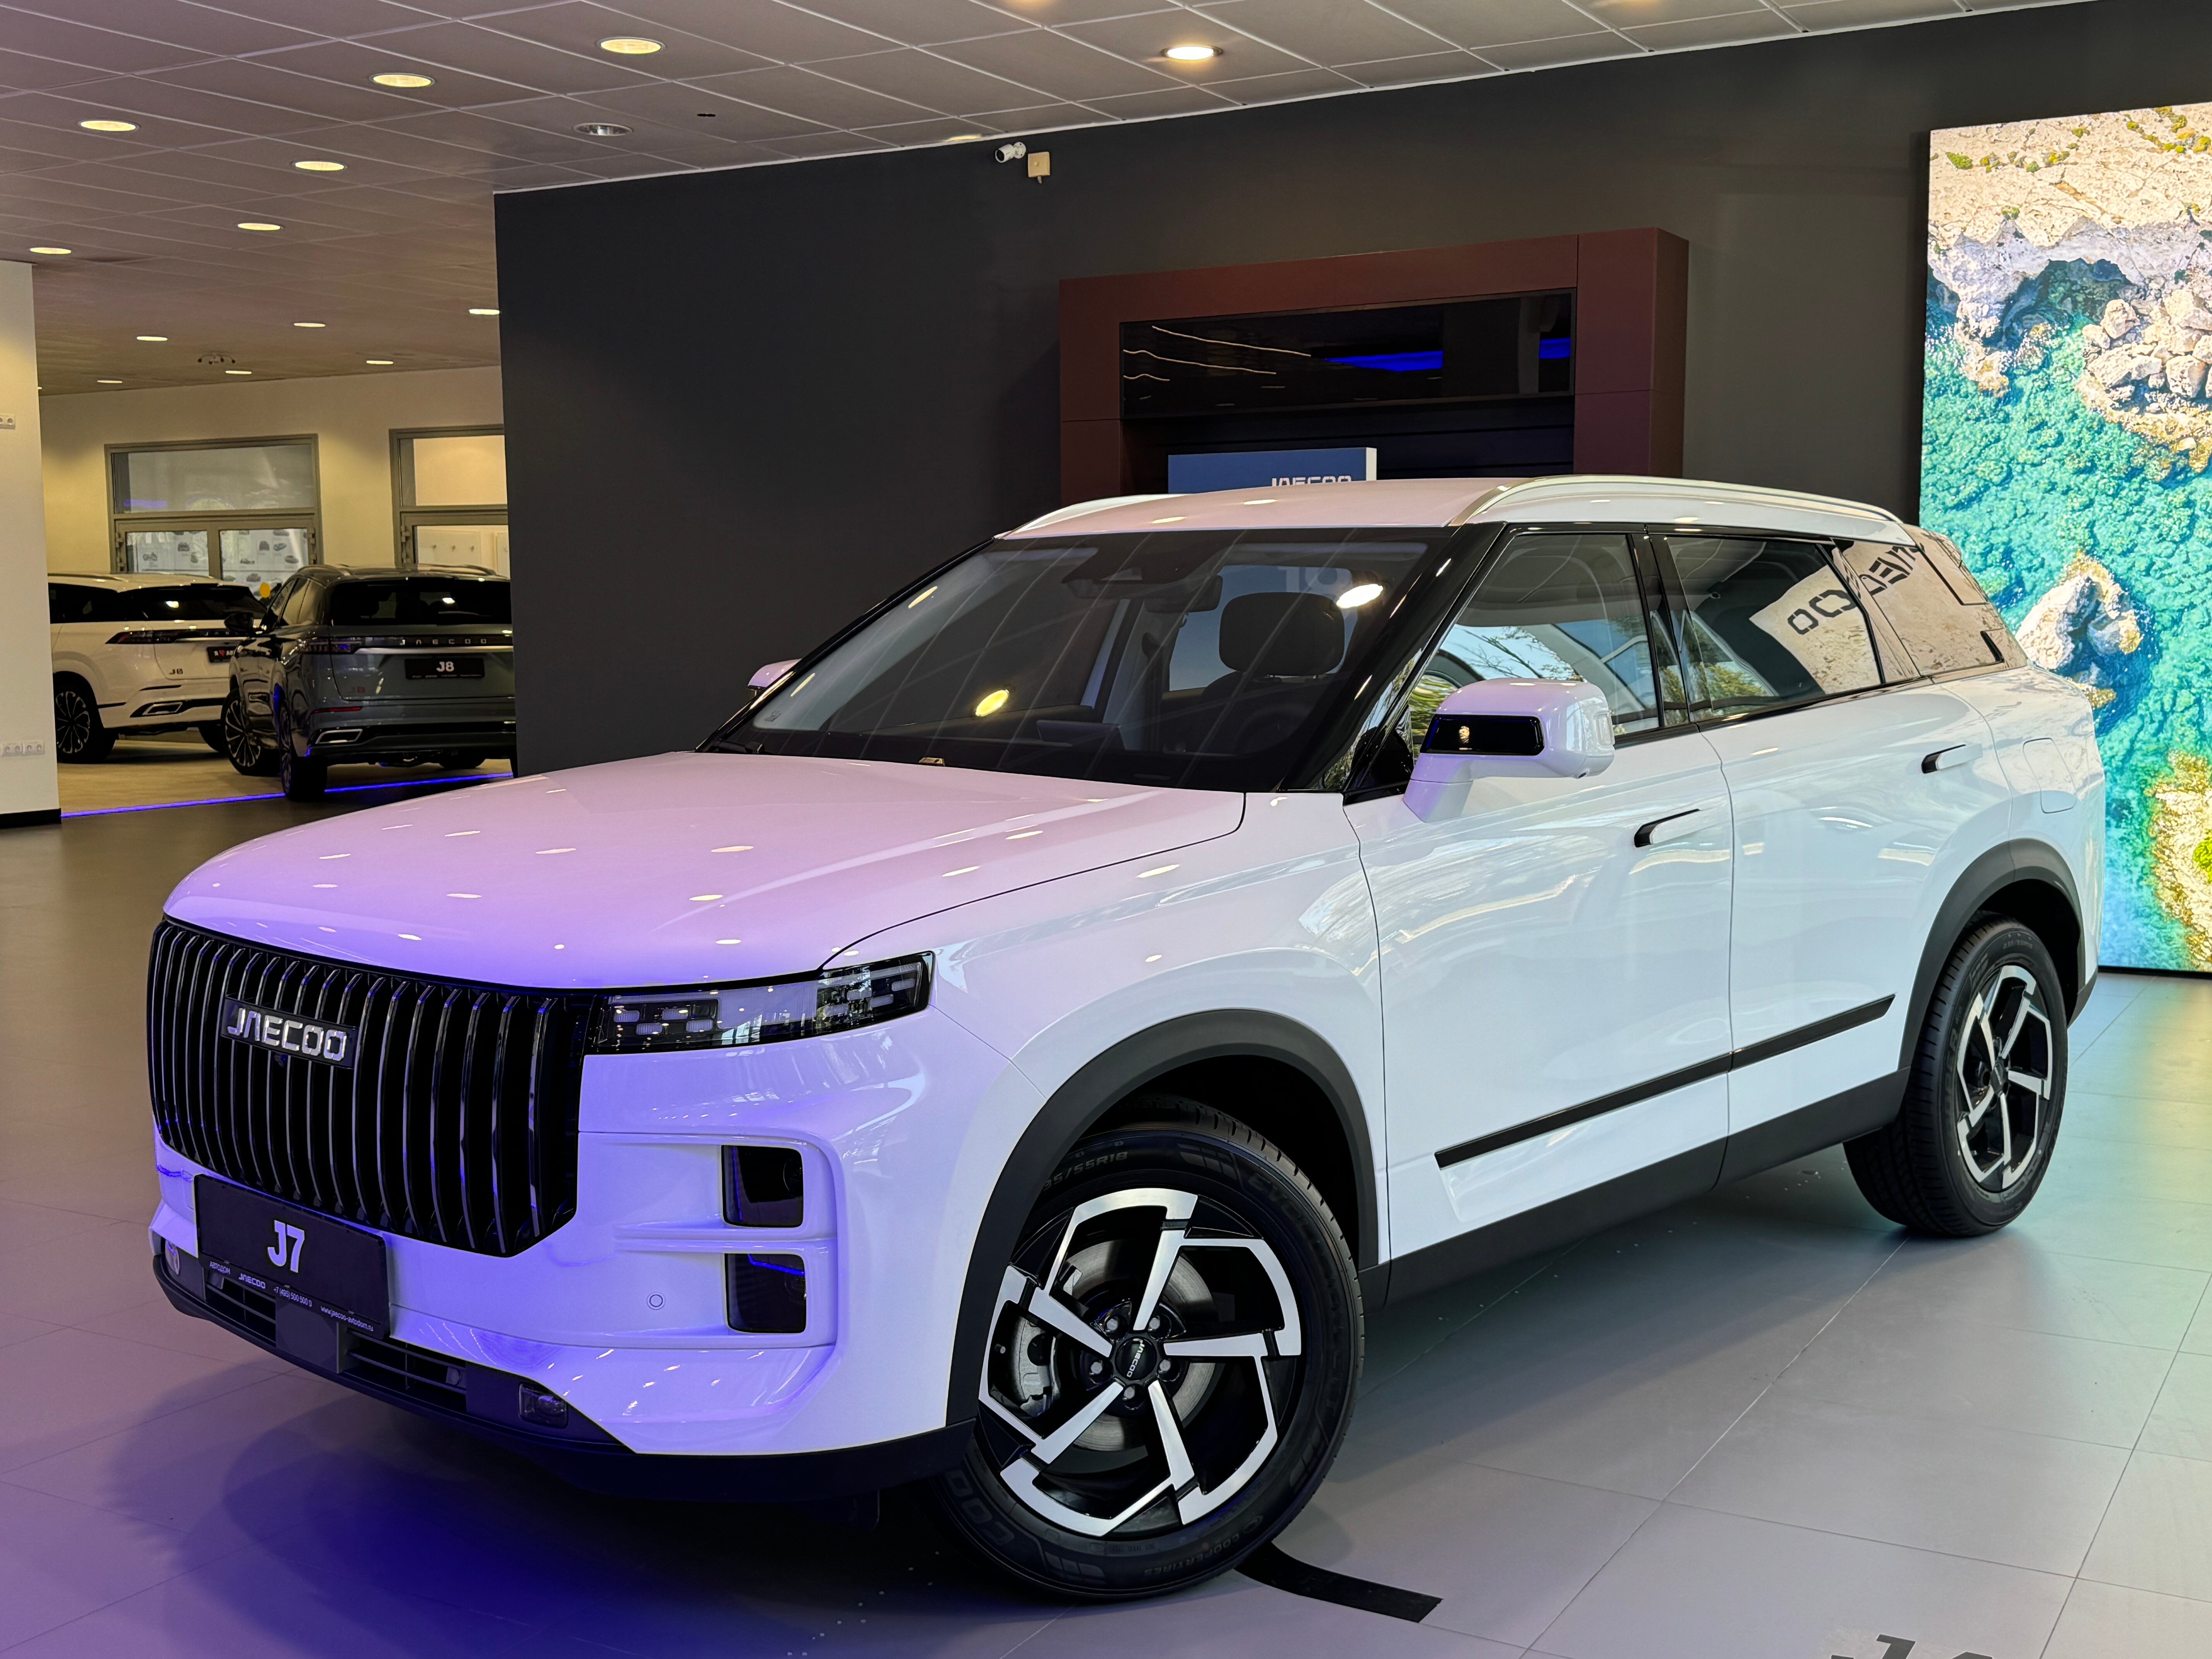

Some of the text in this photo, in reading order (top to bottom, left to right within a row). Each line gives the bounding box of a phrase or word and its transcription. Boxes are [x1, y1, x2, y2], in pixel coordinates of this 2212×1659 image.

[436, 661, 455, 672] J8
[227, 1007, 348, 1062] JAECOO
[267, 1220, 305, 1273] J7
[238, 1273, 266, 1290] JAECOO
